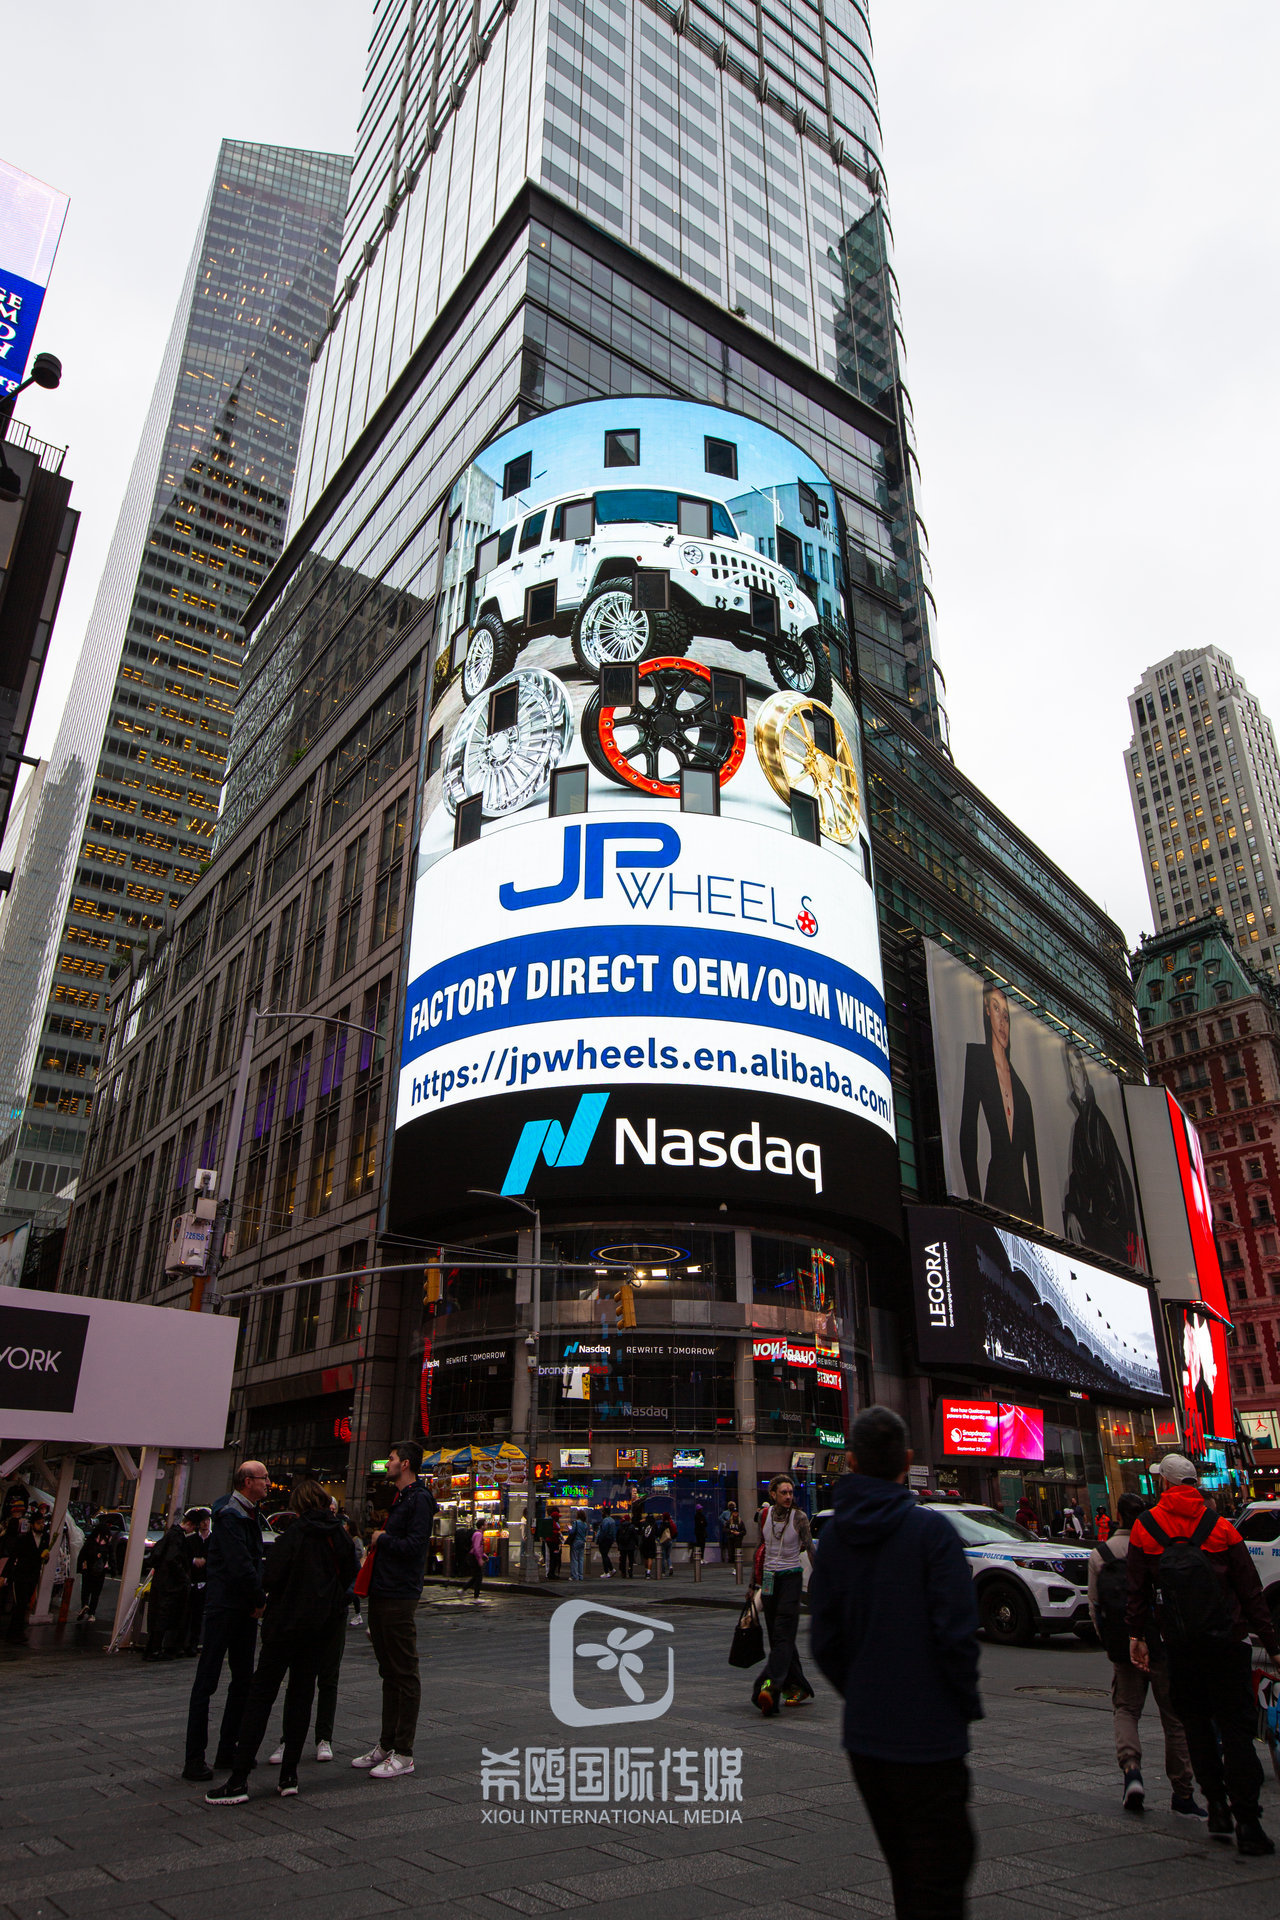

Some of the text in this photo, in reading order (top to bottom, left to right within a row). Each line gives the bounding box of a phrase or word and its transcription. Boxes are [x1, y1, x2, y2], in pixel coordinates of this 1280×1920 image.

[499, 822, 682, 912] JP
[616, 872, 819, 938] WHEELS
[408, 966, 518, 1042] FACTORY
[526, 954, 659, 1001] DIRECT
[672, 955, 830, 1022] OEM/ODM
[615, 1118, 823, 1195] Nasdaq
[924, 1241, 947, 1328] LEGORA
[579, 1345, 716, 1355] Nasdaq REWRITE TOMORROW
[623, 1405, 669, 1420] Nasdaq
